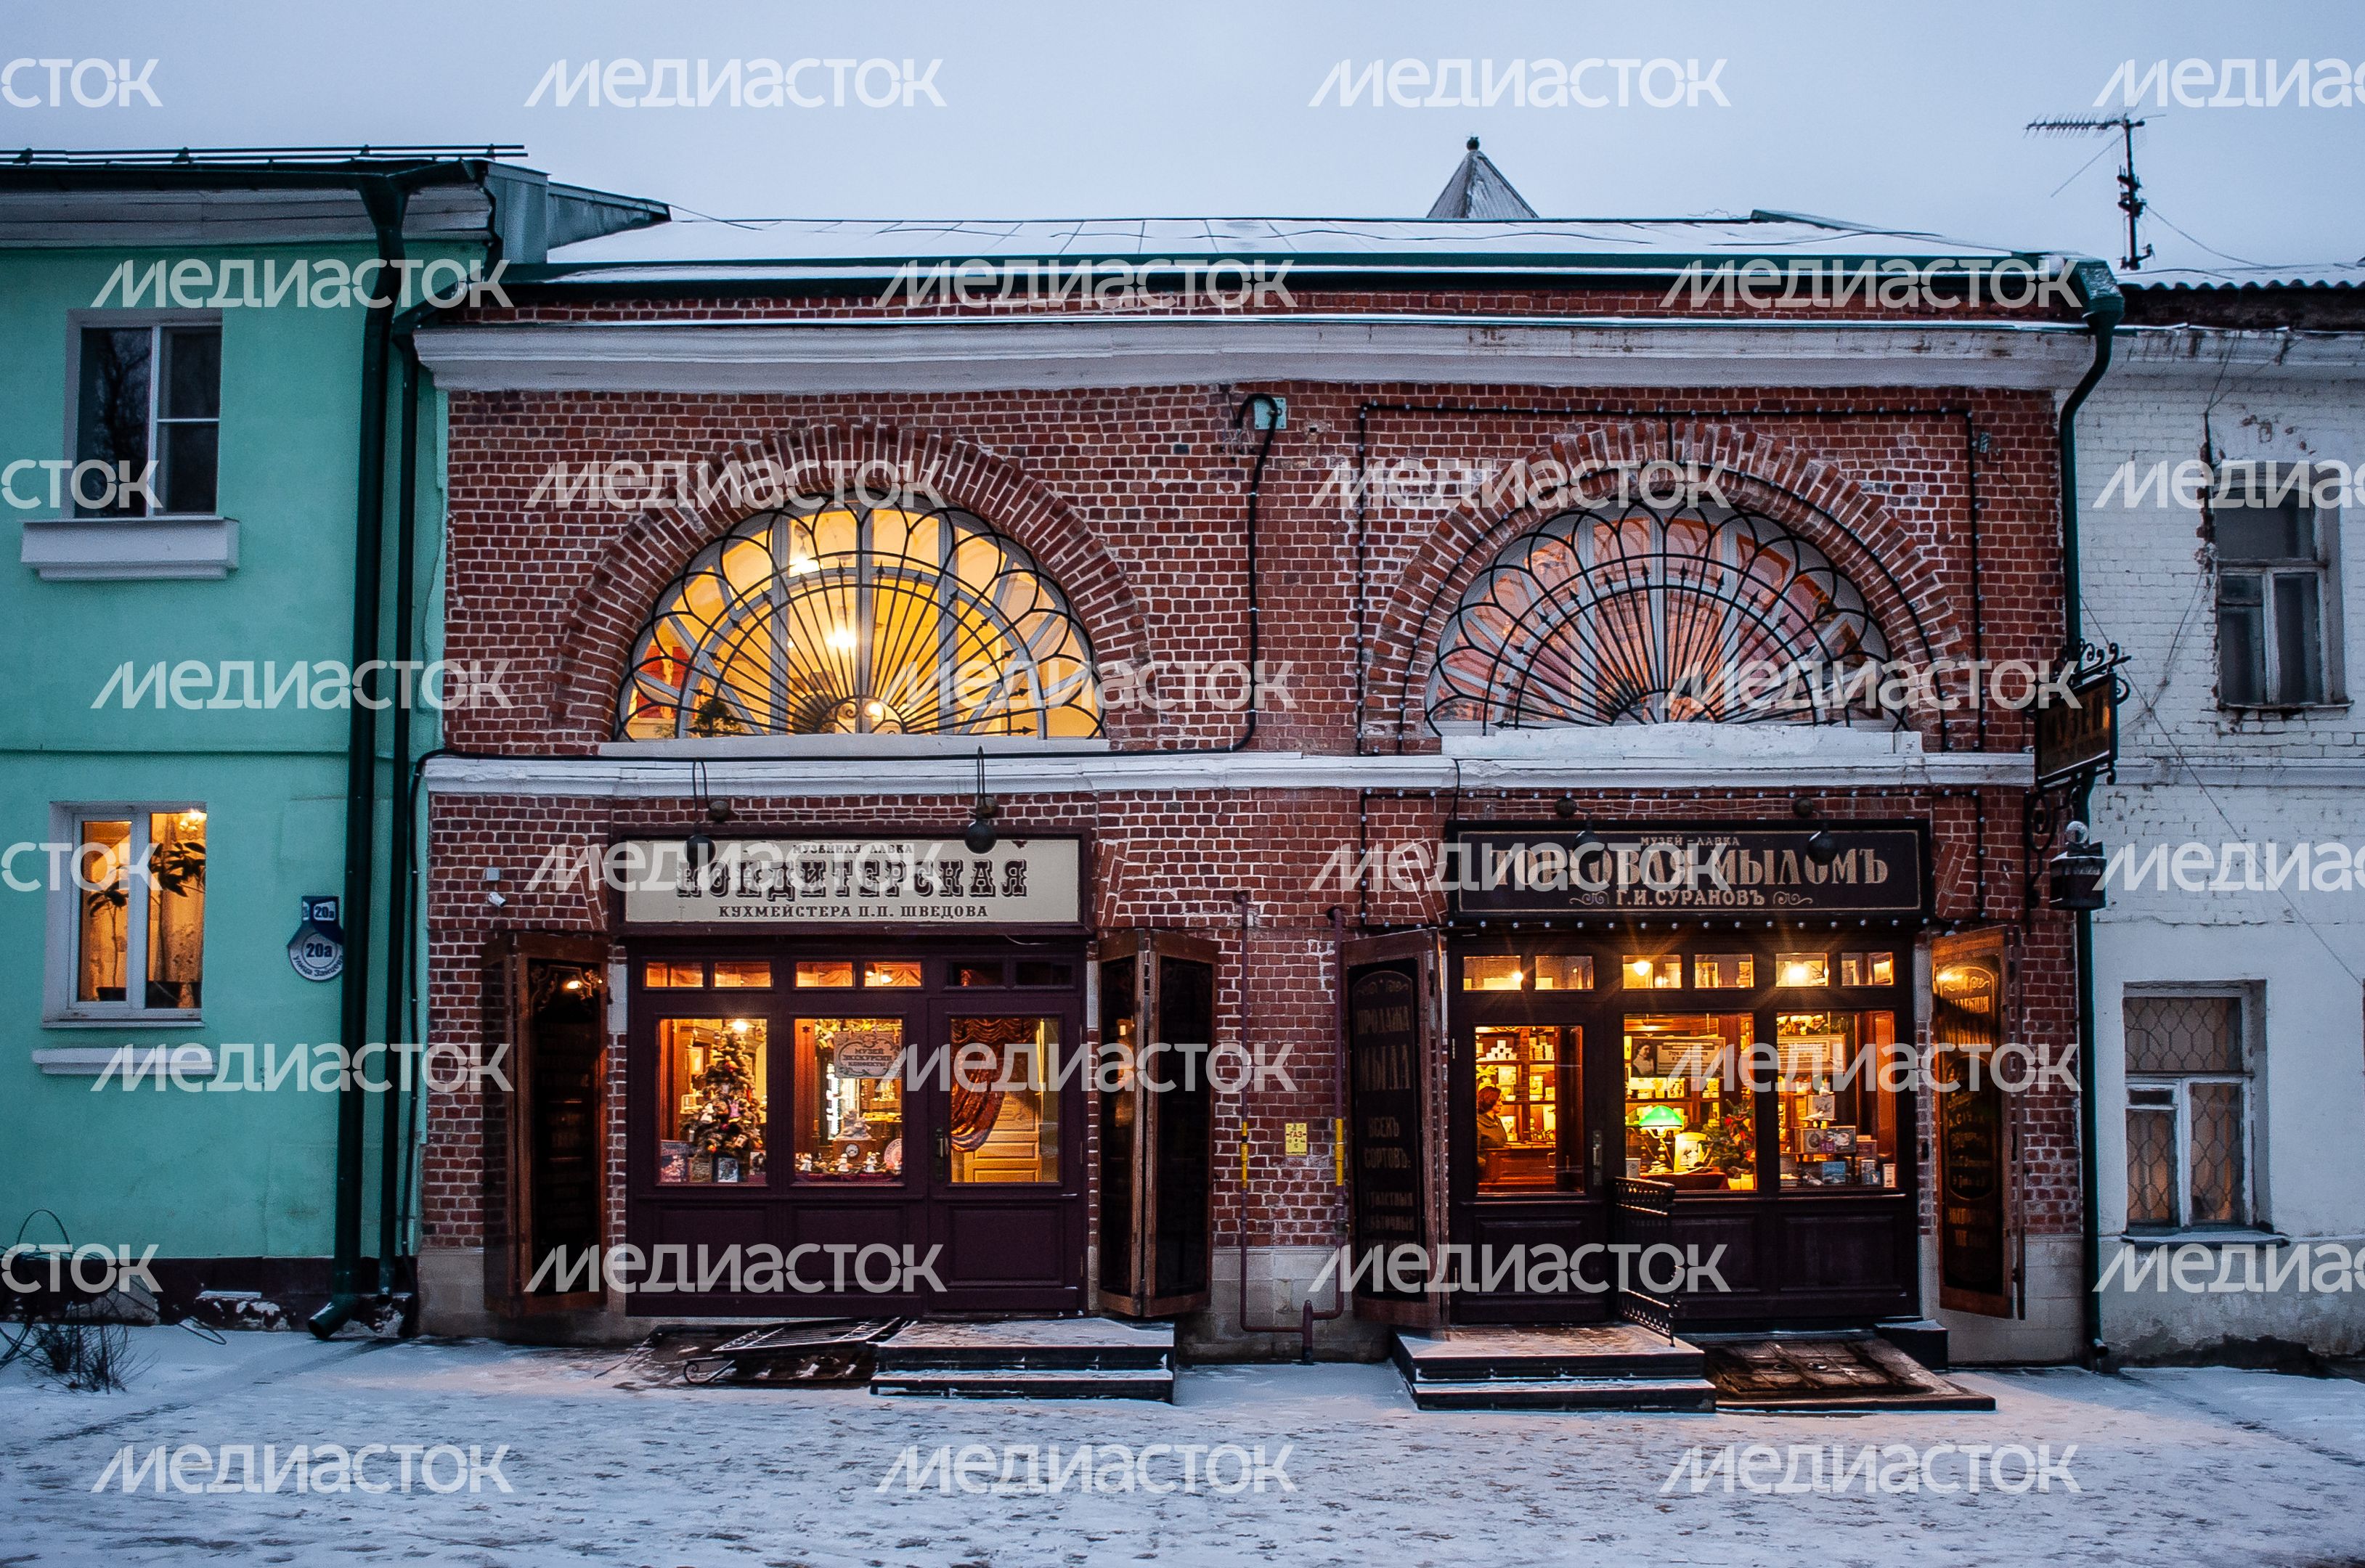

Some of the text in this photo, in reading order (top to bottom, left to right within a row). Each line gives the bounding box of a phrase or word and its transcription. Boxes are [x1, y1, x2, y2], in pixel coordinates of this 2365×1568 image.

[1709, 849, 1888, 885] МЫЛОМЪ
[676, 859, 1027, 902] КОНДИТЕРСКАЯ
[719, 905, 852, 918] КУХМЕЙСТЕРА
[900, 905, 988, 919] ШВЕДОВА
[306, 943, 333, 957] 20а
